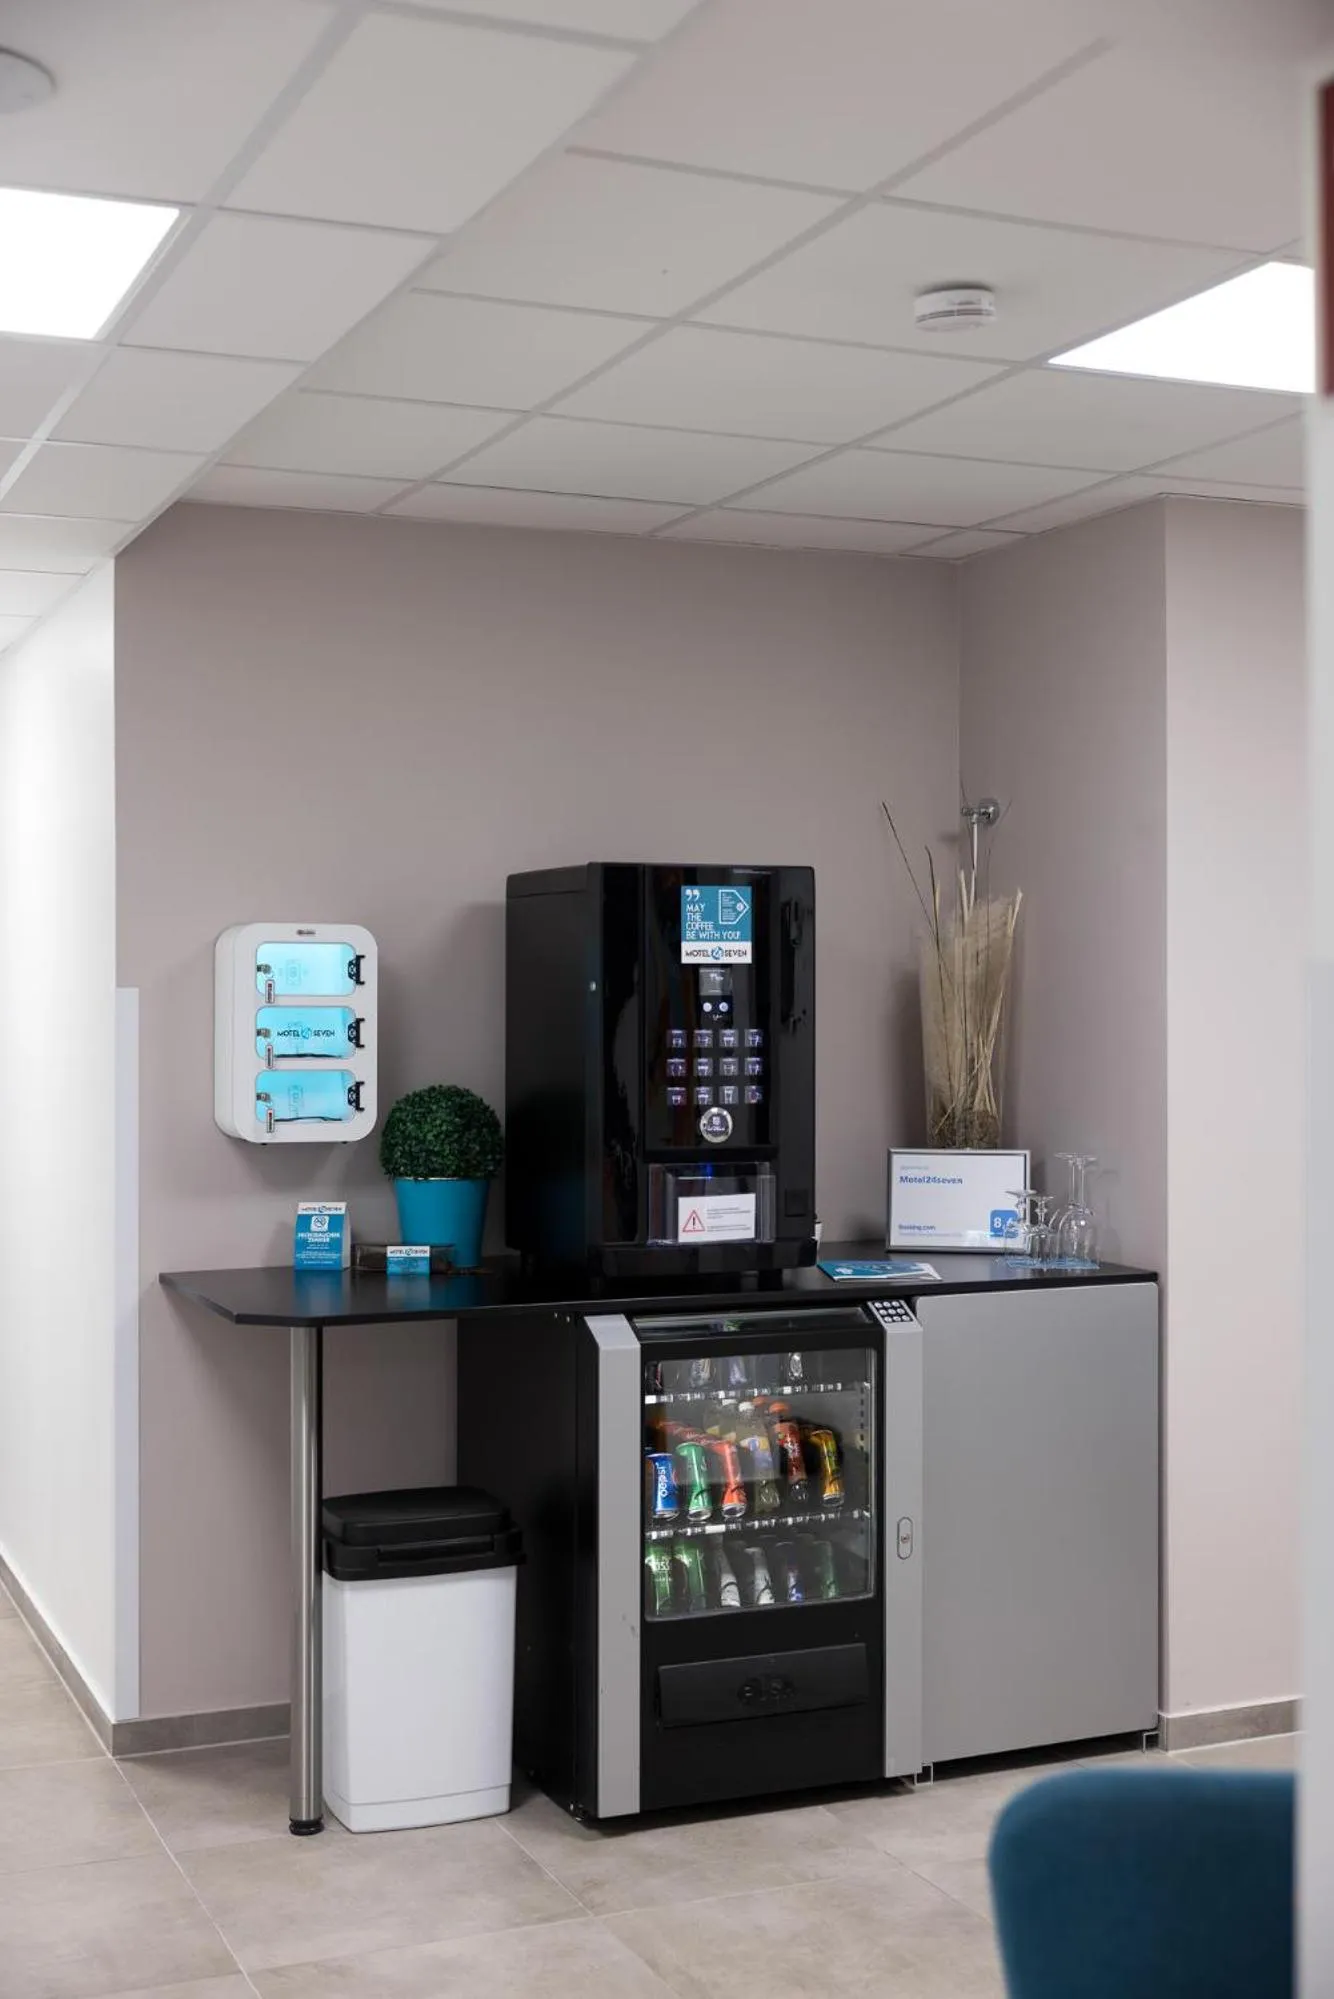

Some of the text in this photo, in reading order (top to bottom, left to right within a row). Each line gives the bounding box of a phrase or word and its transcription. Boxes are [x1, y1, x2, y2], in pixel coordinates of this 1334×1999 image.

[686, 903, 705, 913] MAY
[686, 912, 702, 921] THE
[686, 921, 714, 931] COFFEE
[686, 931, 697, 940] BE
[699, 931, 720, 940] WITH
[685, 949, 747, 958] MOTEL SEVEN
[277, 1029, 335, 1037] MOTEL SEVEN
